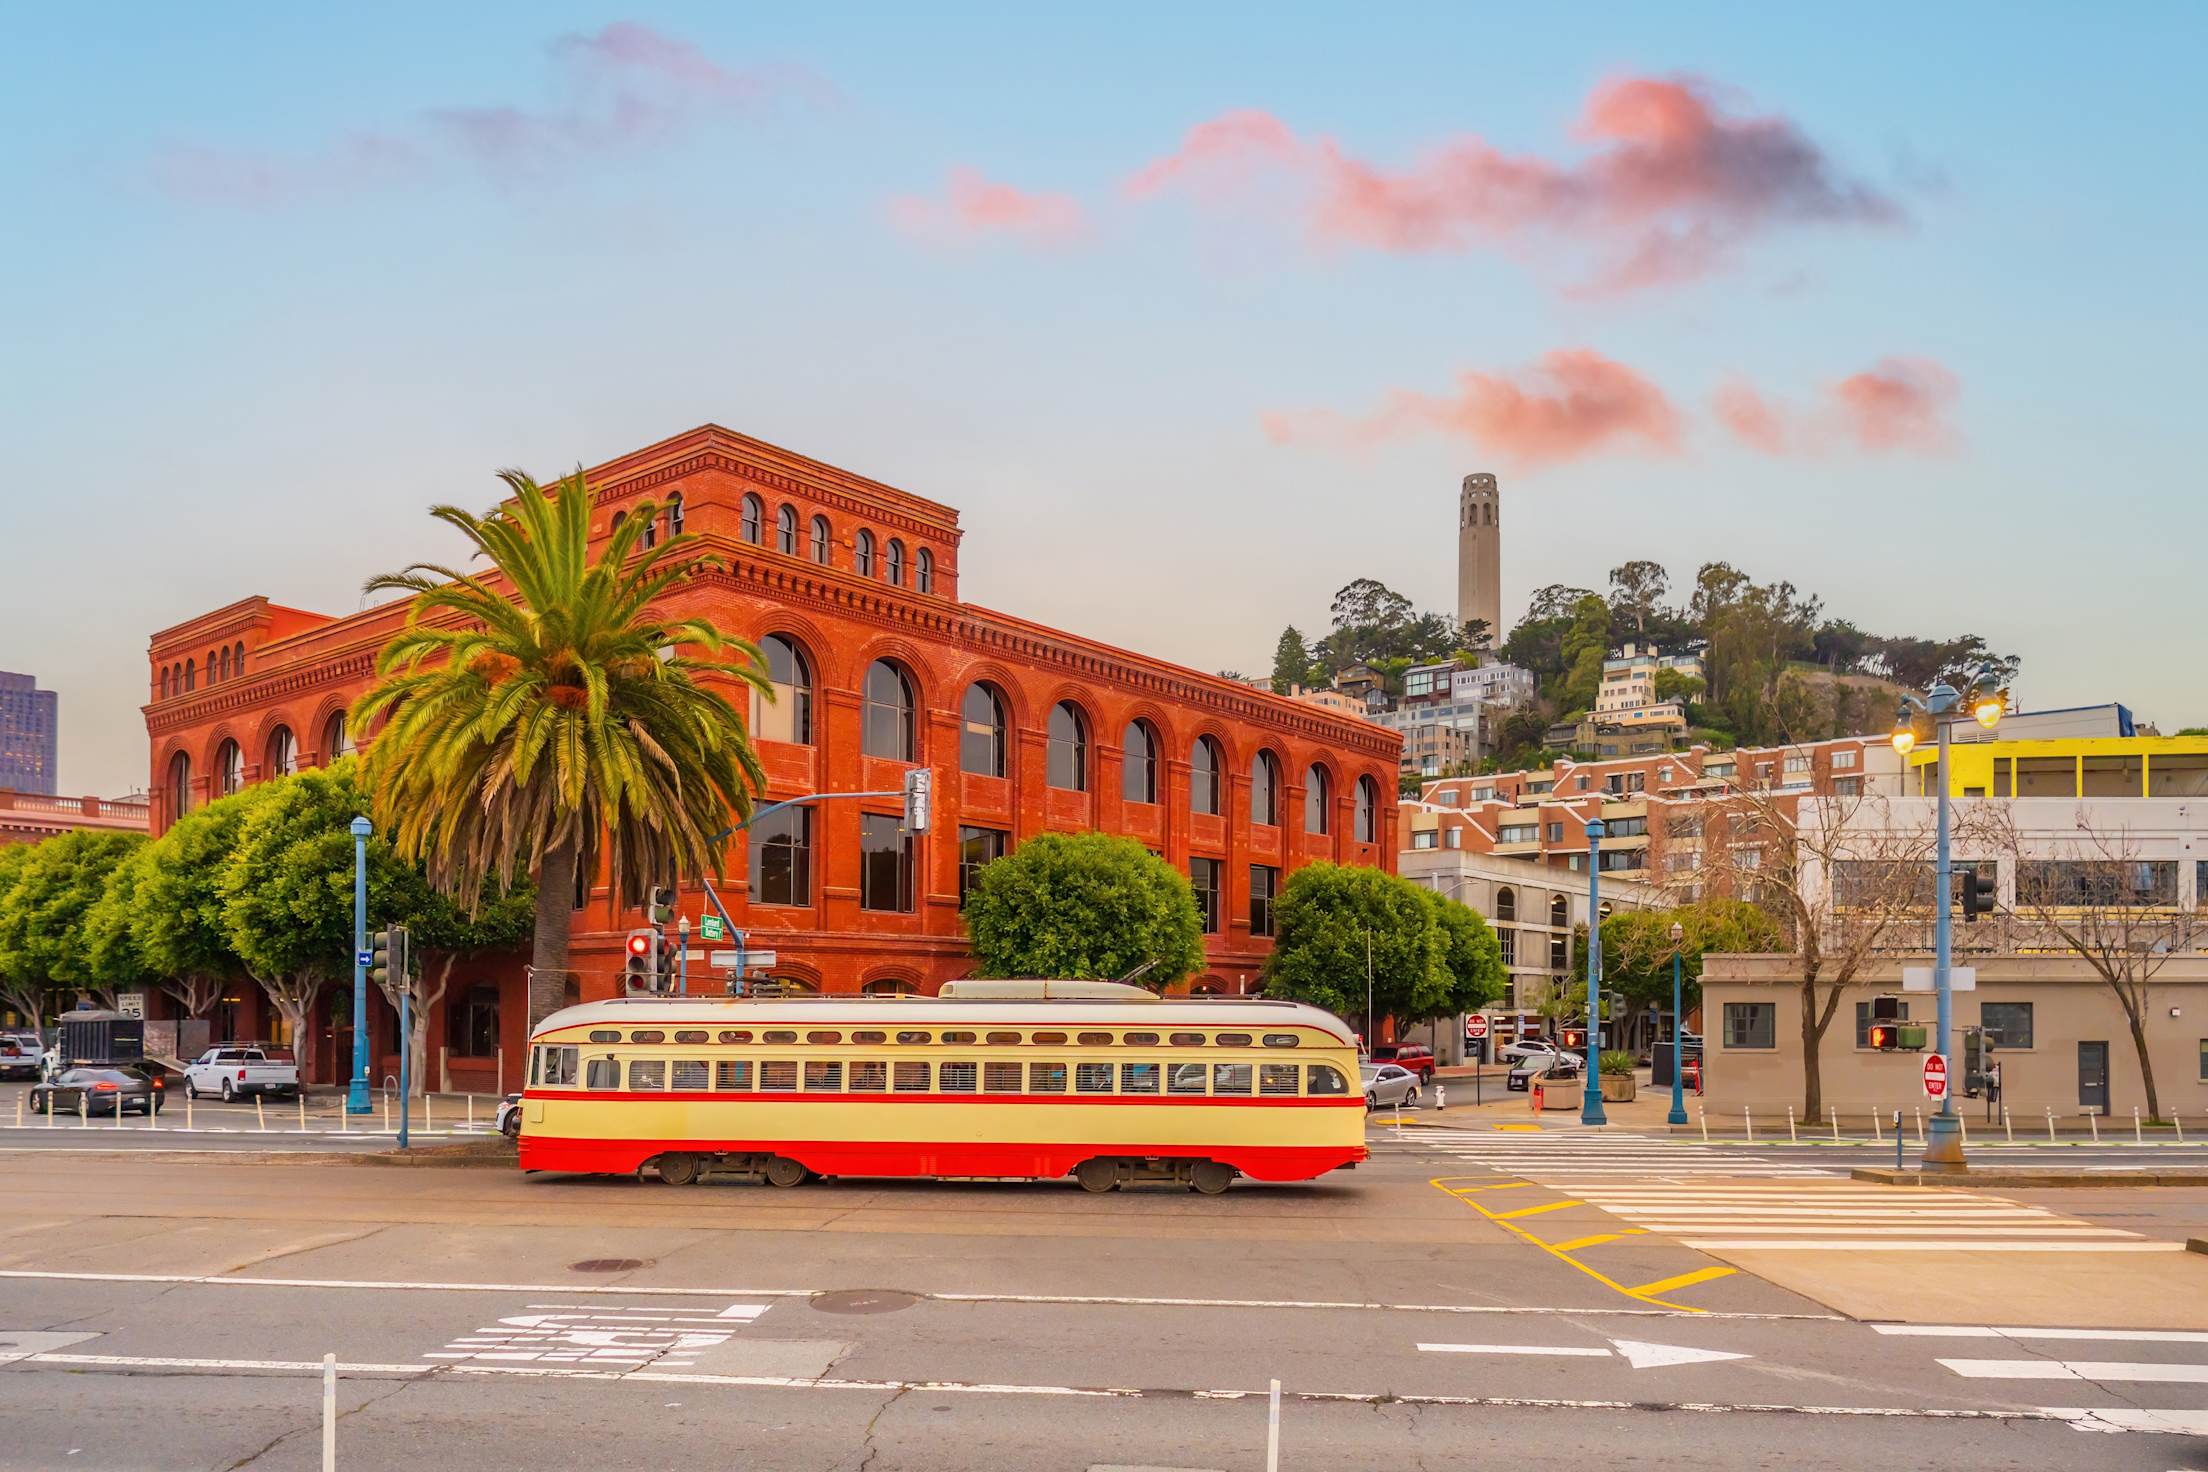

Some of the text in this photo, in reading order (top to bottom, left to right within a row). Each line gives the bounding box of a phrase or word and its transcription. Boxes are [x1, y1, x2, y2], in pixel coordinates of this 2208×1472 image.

[1926, 1063, 1944, 1071] DO NOT
[1928, 1081, 1942, 1090] ENTER
